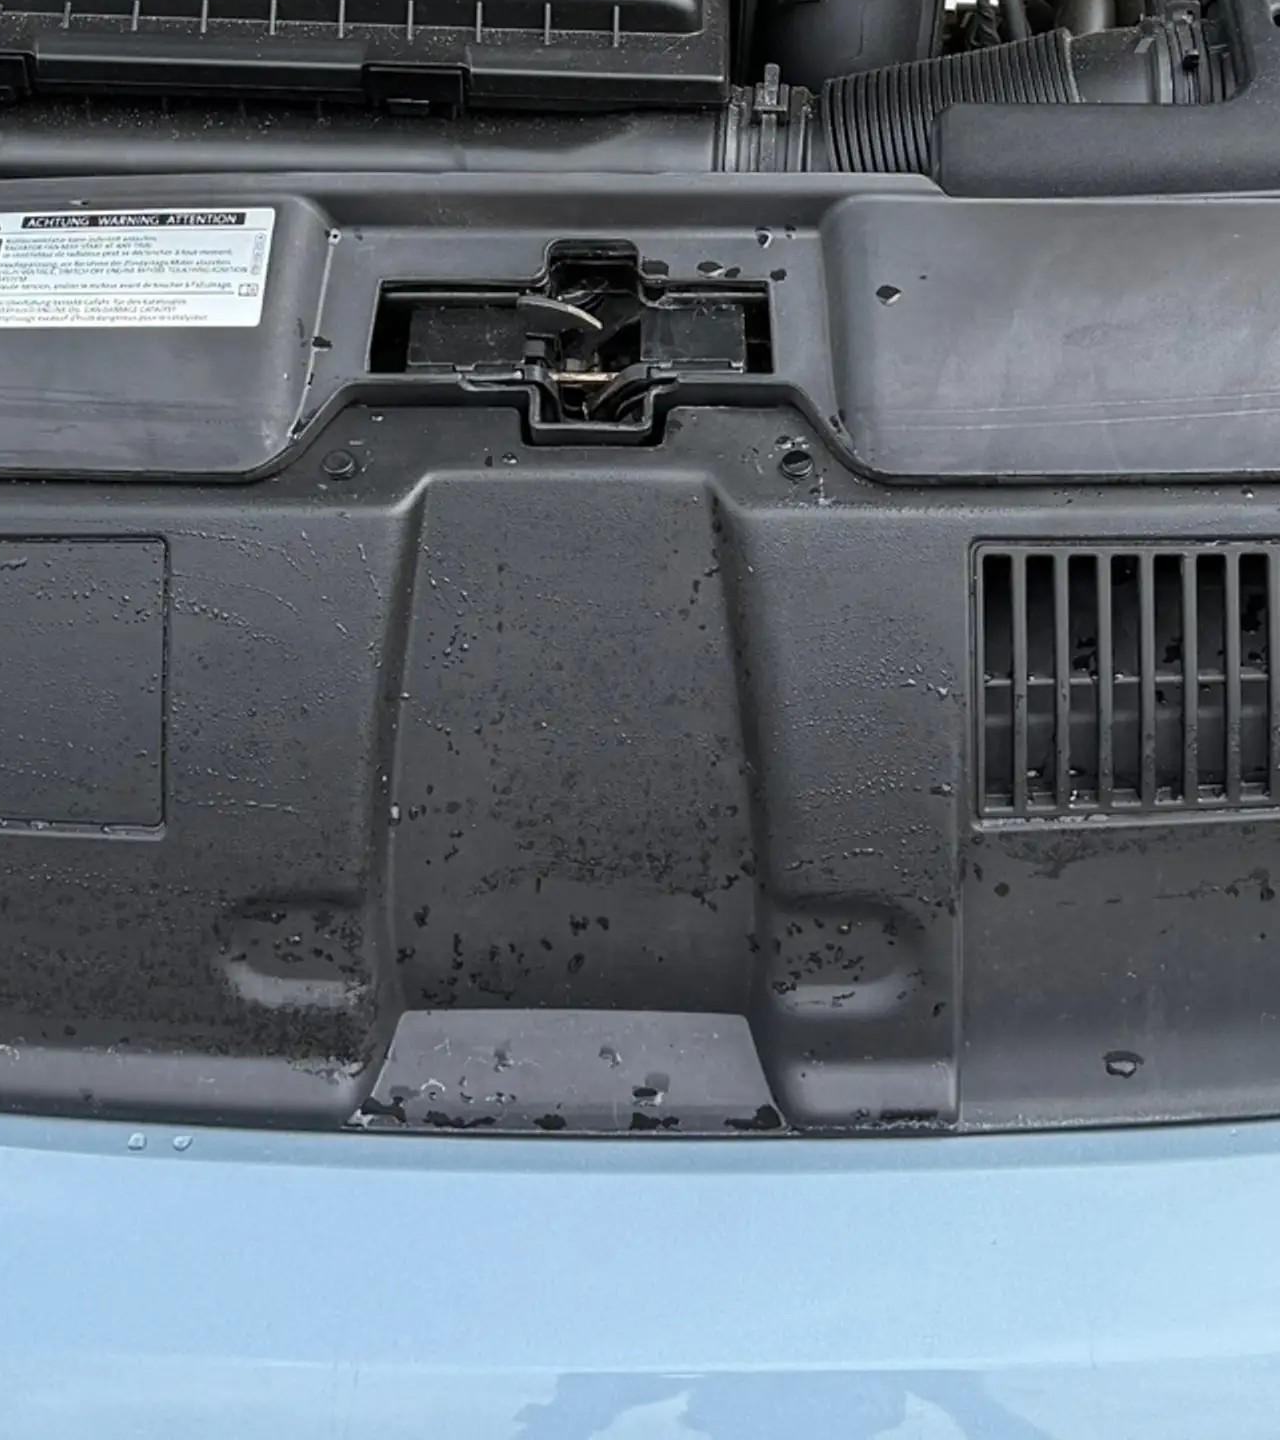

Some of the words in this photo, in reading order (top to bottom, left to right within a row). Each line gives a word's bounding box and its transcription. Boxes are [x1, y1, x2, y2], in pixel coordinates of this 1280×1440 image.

[27, 217, 90, 227] ACHTUNG
[98, 215, 159, 226] WARNING
[166, 213, 237, 225] ATTENTION
